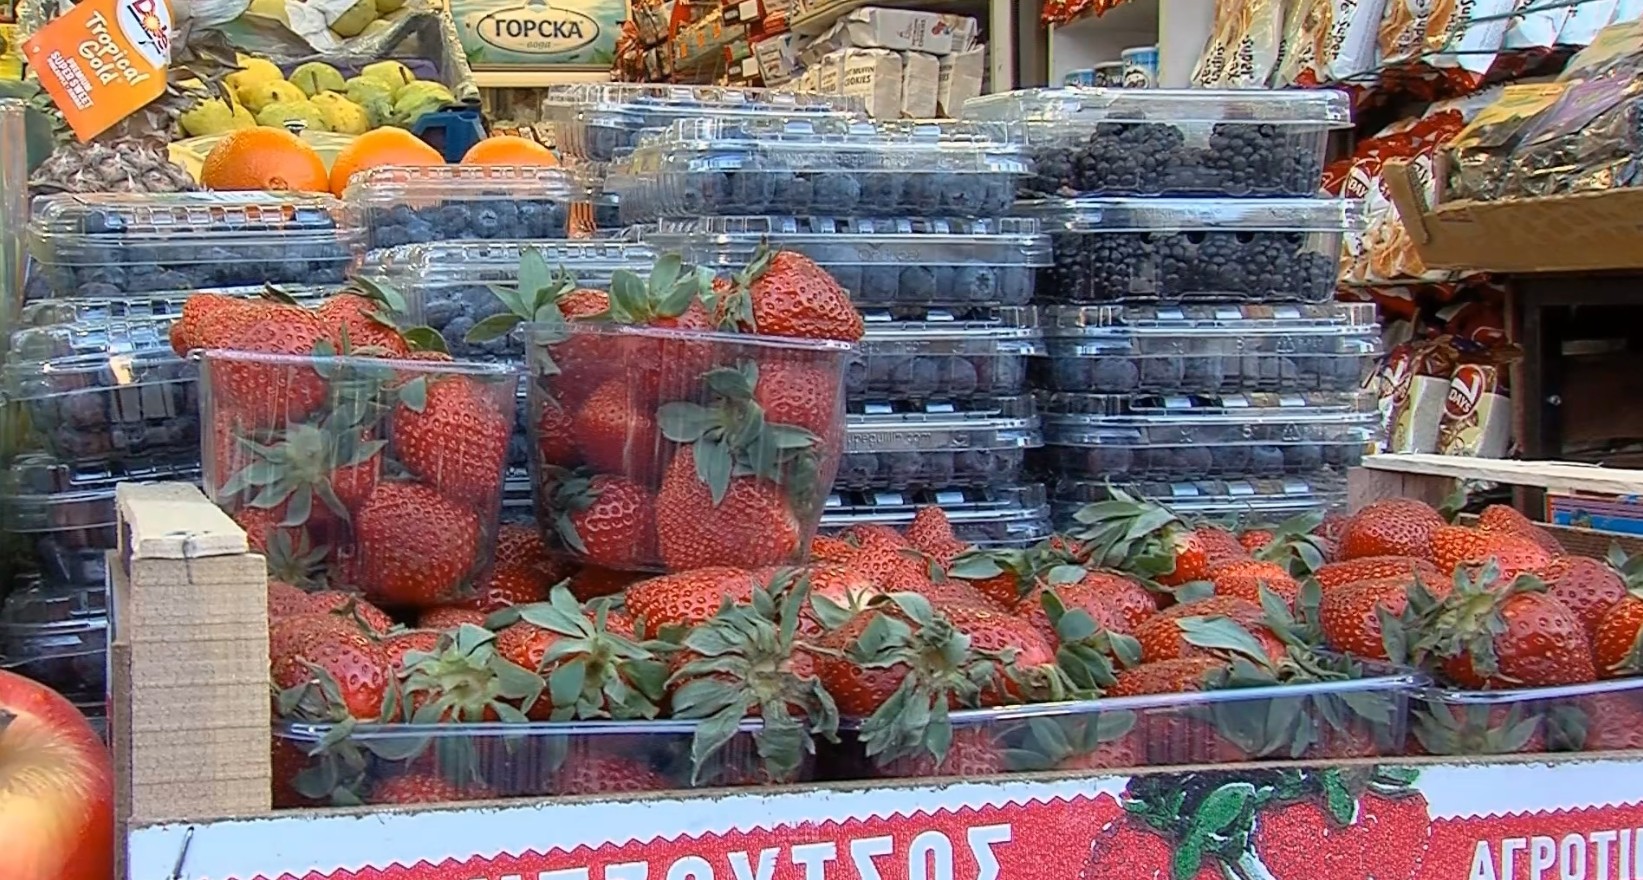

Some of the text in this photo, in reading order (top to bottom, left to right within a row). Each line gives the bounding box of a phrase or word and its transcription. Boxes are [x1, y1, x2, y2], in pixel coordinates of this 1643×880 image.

[495, 19, 583, 38] ГОРСКА
[79, 40, 119, 86] Gold
[86, 10, 150, 86] Tropical
[50, 50, 94, 107] SUPER SWEET
[844, 75, 871, 87] COOKIES
[1348, 179, 1368, 198] DAY
[1448, 388, 1472, 413] DAYS
[1451, 374, 1480, 404] 7
[1469, 827, 1643, 880] ΑΓΡΟΤΙ
